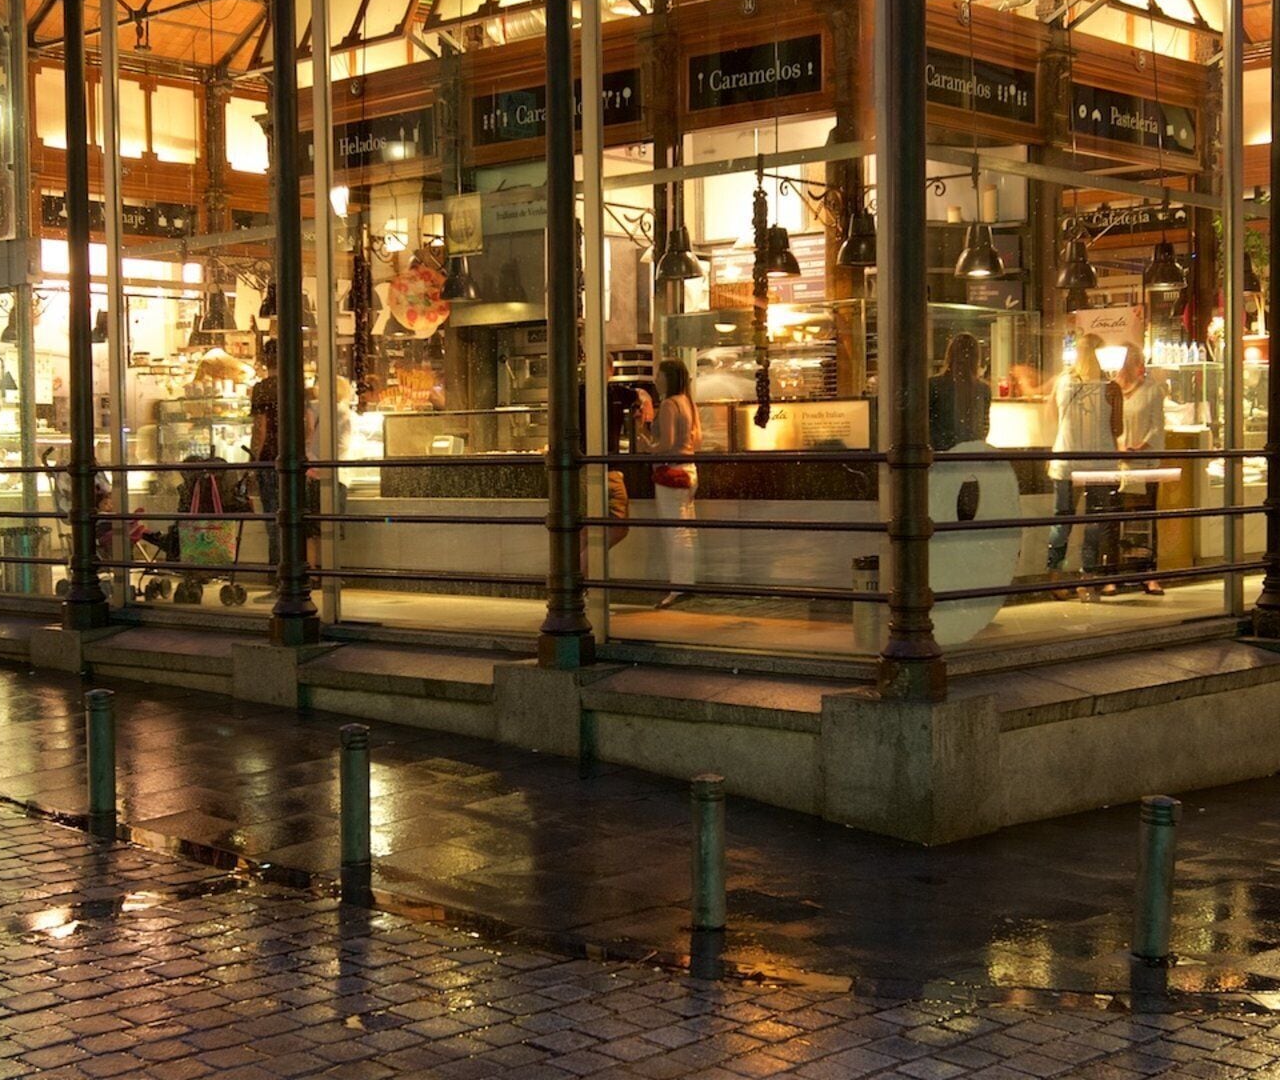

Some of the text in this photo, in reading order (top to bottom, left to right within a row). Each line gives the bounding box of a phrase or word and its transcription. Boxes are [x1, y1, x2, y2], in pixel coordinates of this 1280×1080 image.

[709, 60, 801, 91] Caramelos
[925, 64, 991, 99] Caramelos
[1110, 106, 1158, 134] Pastelería
[339, 134, 387, 156] Helados
